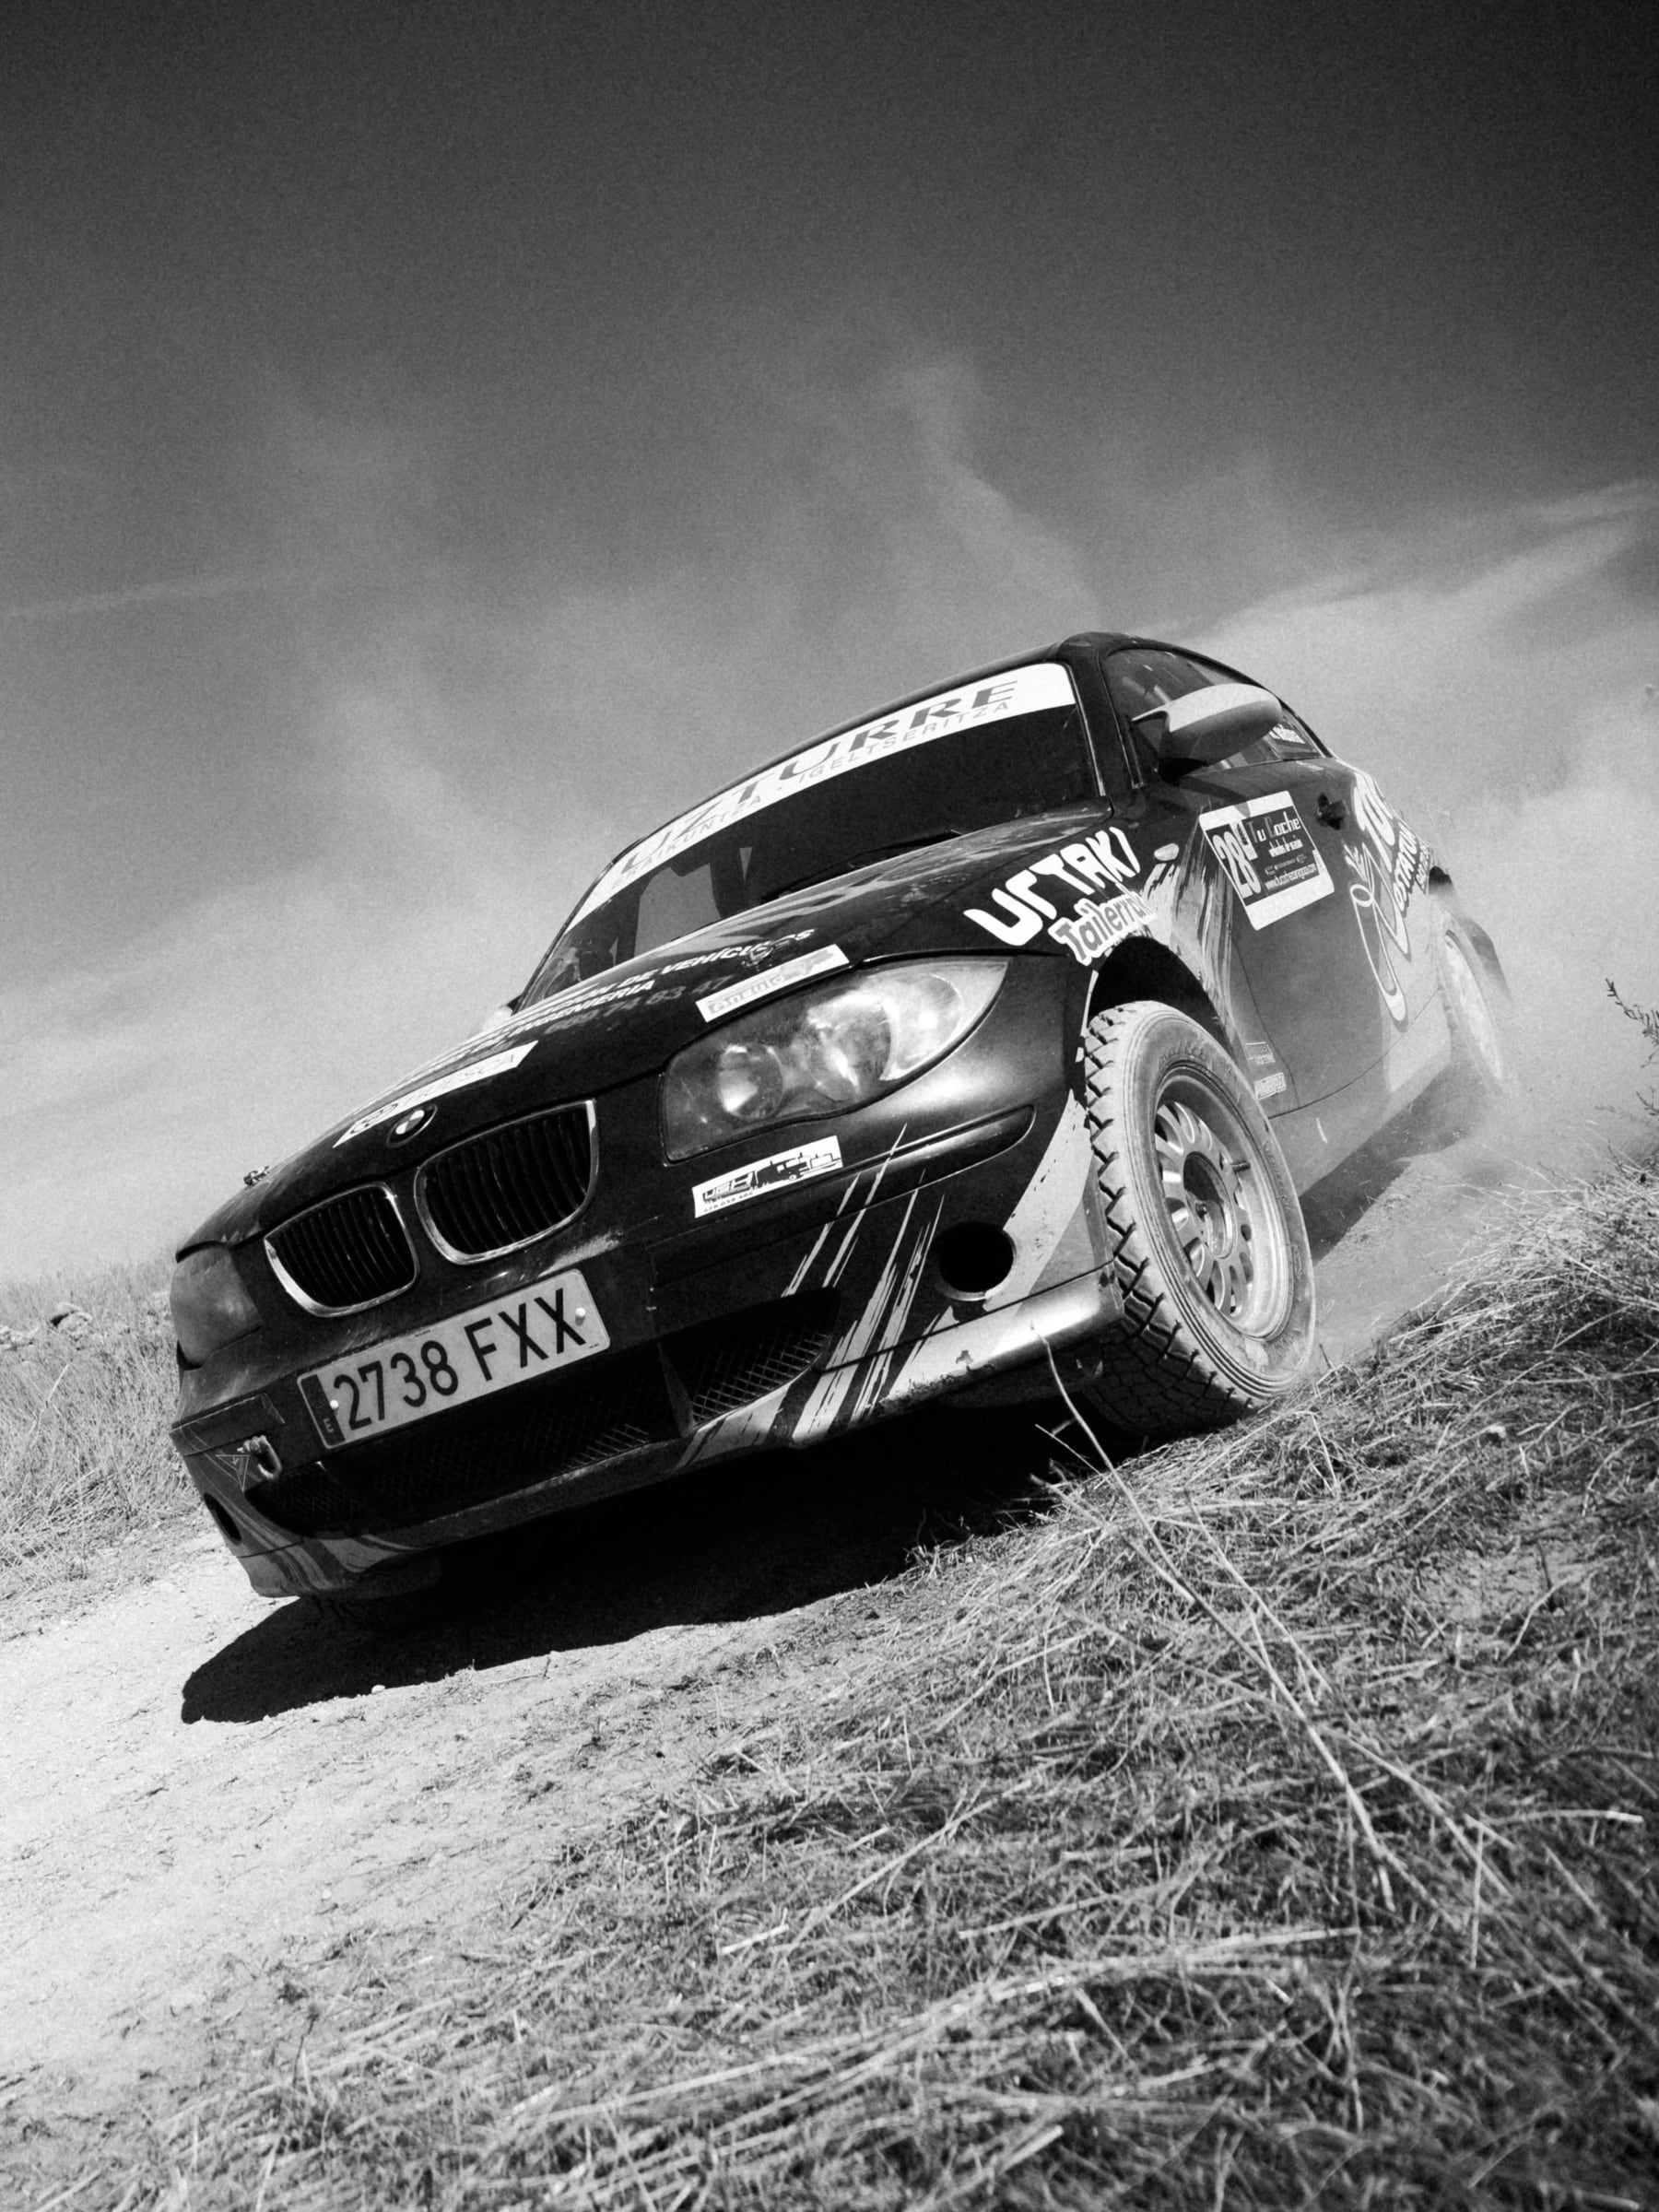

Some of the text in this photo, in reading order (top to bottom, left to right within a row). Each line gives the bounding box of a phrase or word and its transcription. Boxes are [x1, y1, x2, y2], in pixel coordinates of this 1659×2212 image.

[620, 680, 1018, 876] UZTURRE
[798, 700, 1010, 783] IGELTSERITZA
[1264, 810, 1301, 838] Coche
[334, 1287, 587, 1431] 2738 FXX
